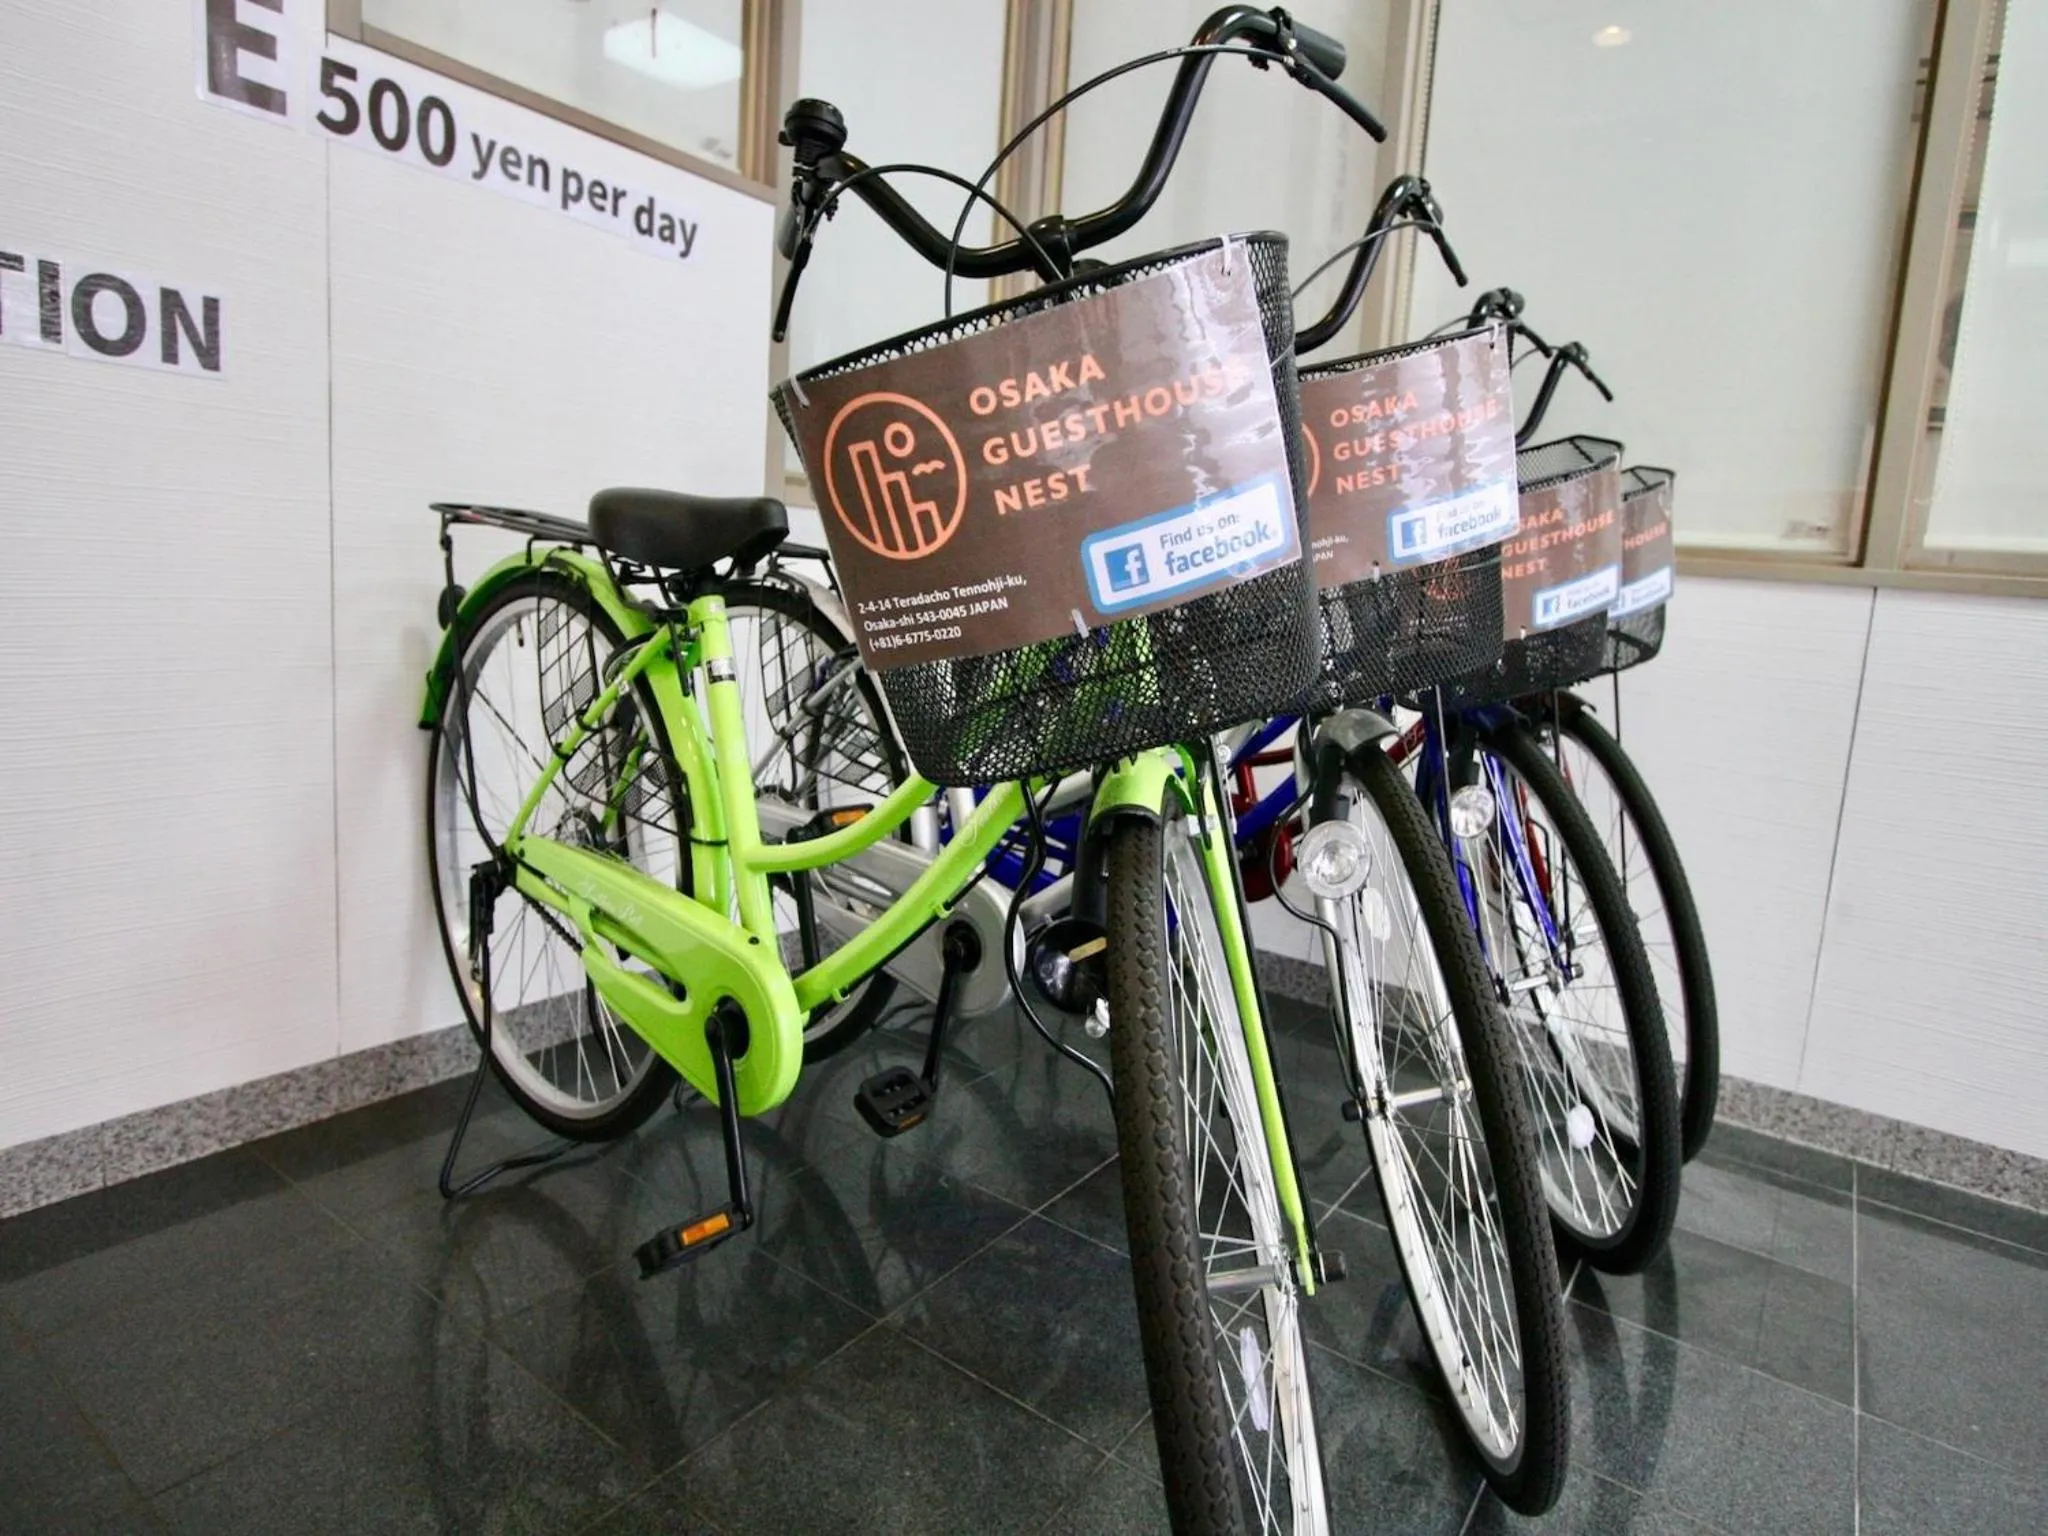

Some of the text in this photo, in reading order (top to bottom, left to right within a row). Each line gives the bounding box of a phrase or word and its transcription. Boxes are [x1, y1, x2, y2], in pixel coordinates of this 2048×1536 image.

[206, 0, 698, 259] E 500 yen per day
[969, 354, 1106, 416] OSAKA
[1330, 390, 1418, 428] OSAKA
[1334, 397, 1499, 461] GUESTHOUSE
[993, 463, 1091, 516] NEST
[1336, 463, 1400, 495] NEST
[1159, 529, 1193, 550] Find
[1164, 520, 1271, 577] facebook
[1502, 510, 1615, 558] GUESTHOUSE
[1502, 558, 1547, 579] NEST
[857, 574, 1028, 614] 2-4-14 Teradacho Tennohji-ku,
[864, 597, 1009, 632] Osaka-shi 543-0045 JAPAN
[869, 626, 962, 651] (+81)6-6775-0220
